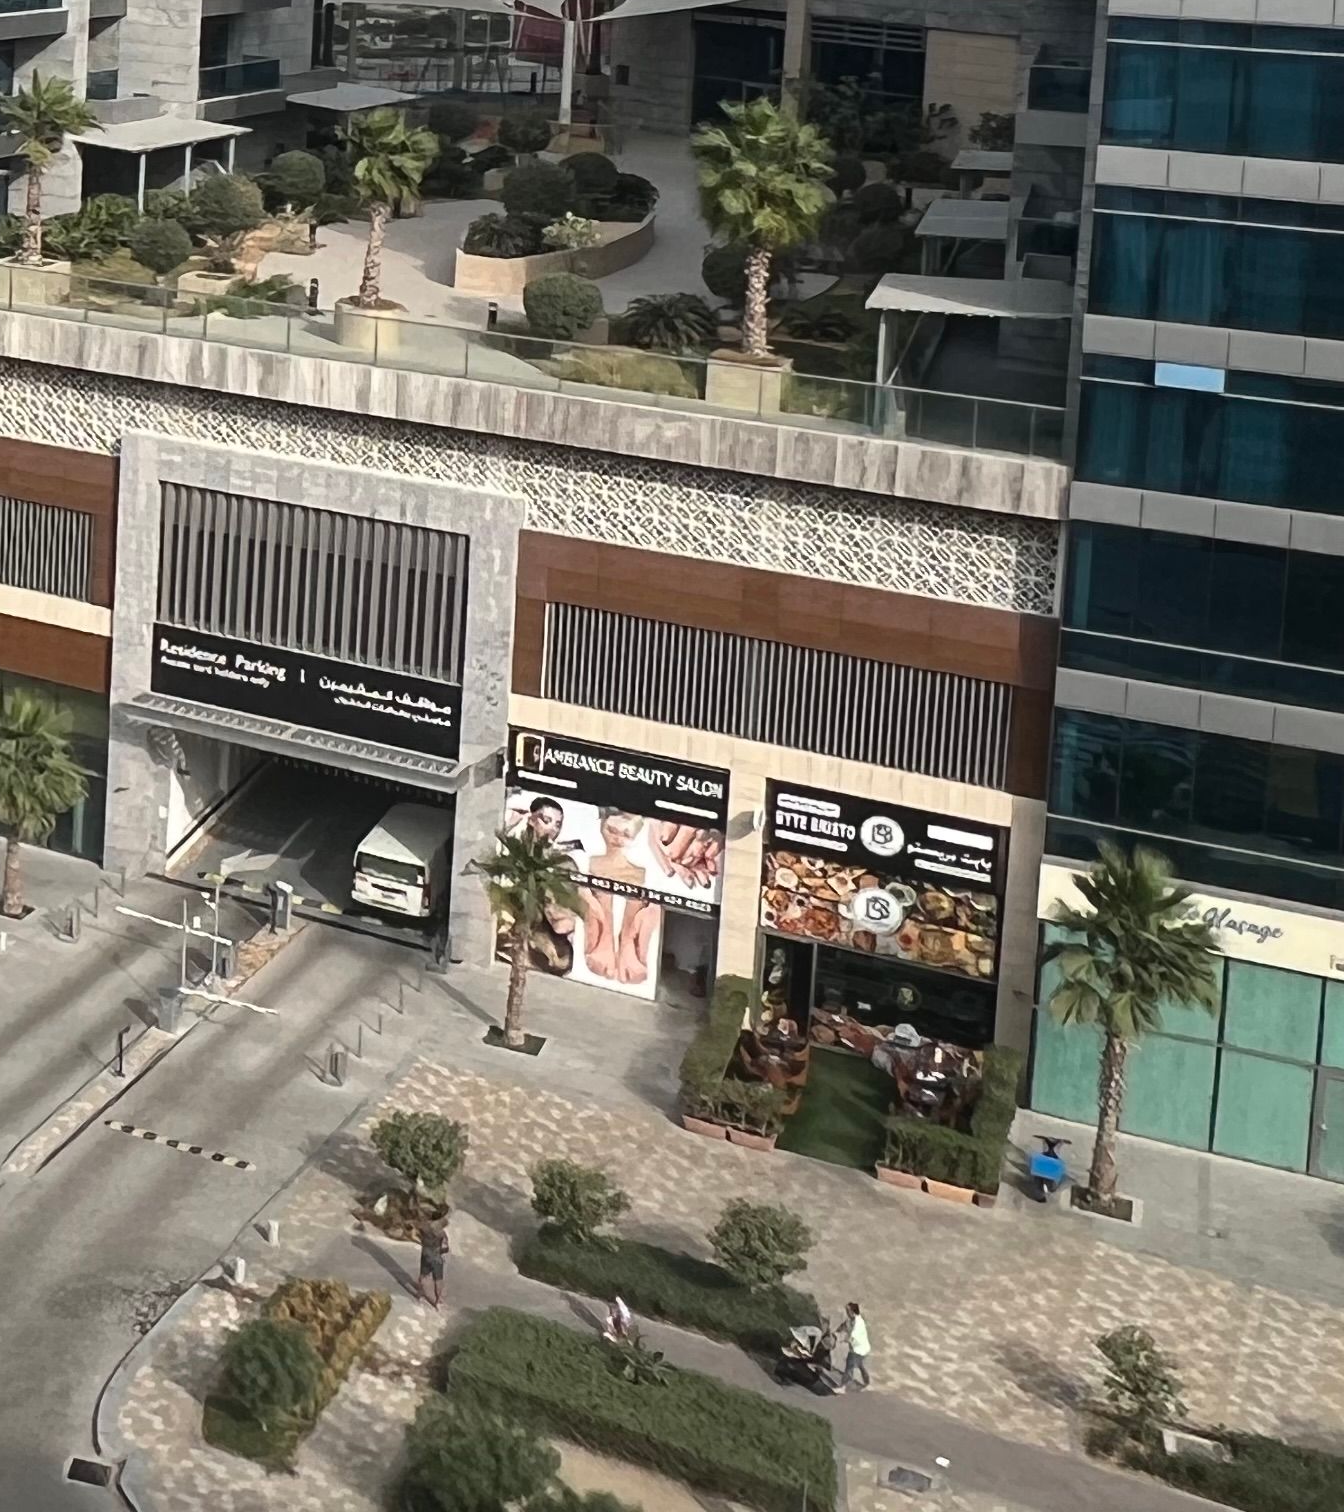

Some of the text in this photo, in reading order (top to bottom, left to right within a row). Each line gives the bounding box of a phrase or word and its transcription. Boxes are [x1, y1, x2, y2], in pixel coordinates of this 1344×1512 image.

[235, 654, 286, 681] Parking
[618, 763, 673, 788] BEAUTY
[675, 775, 723, 799] SALON
